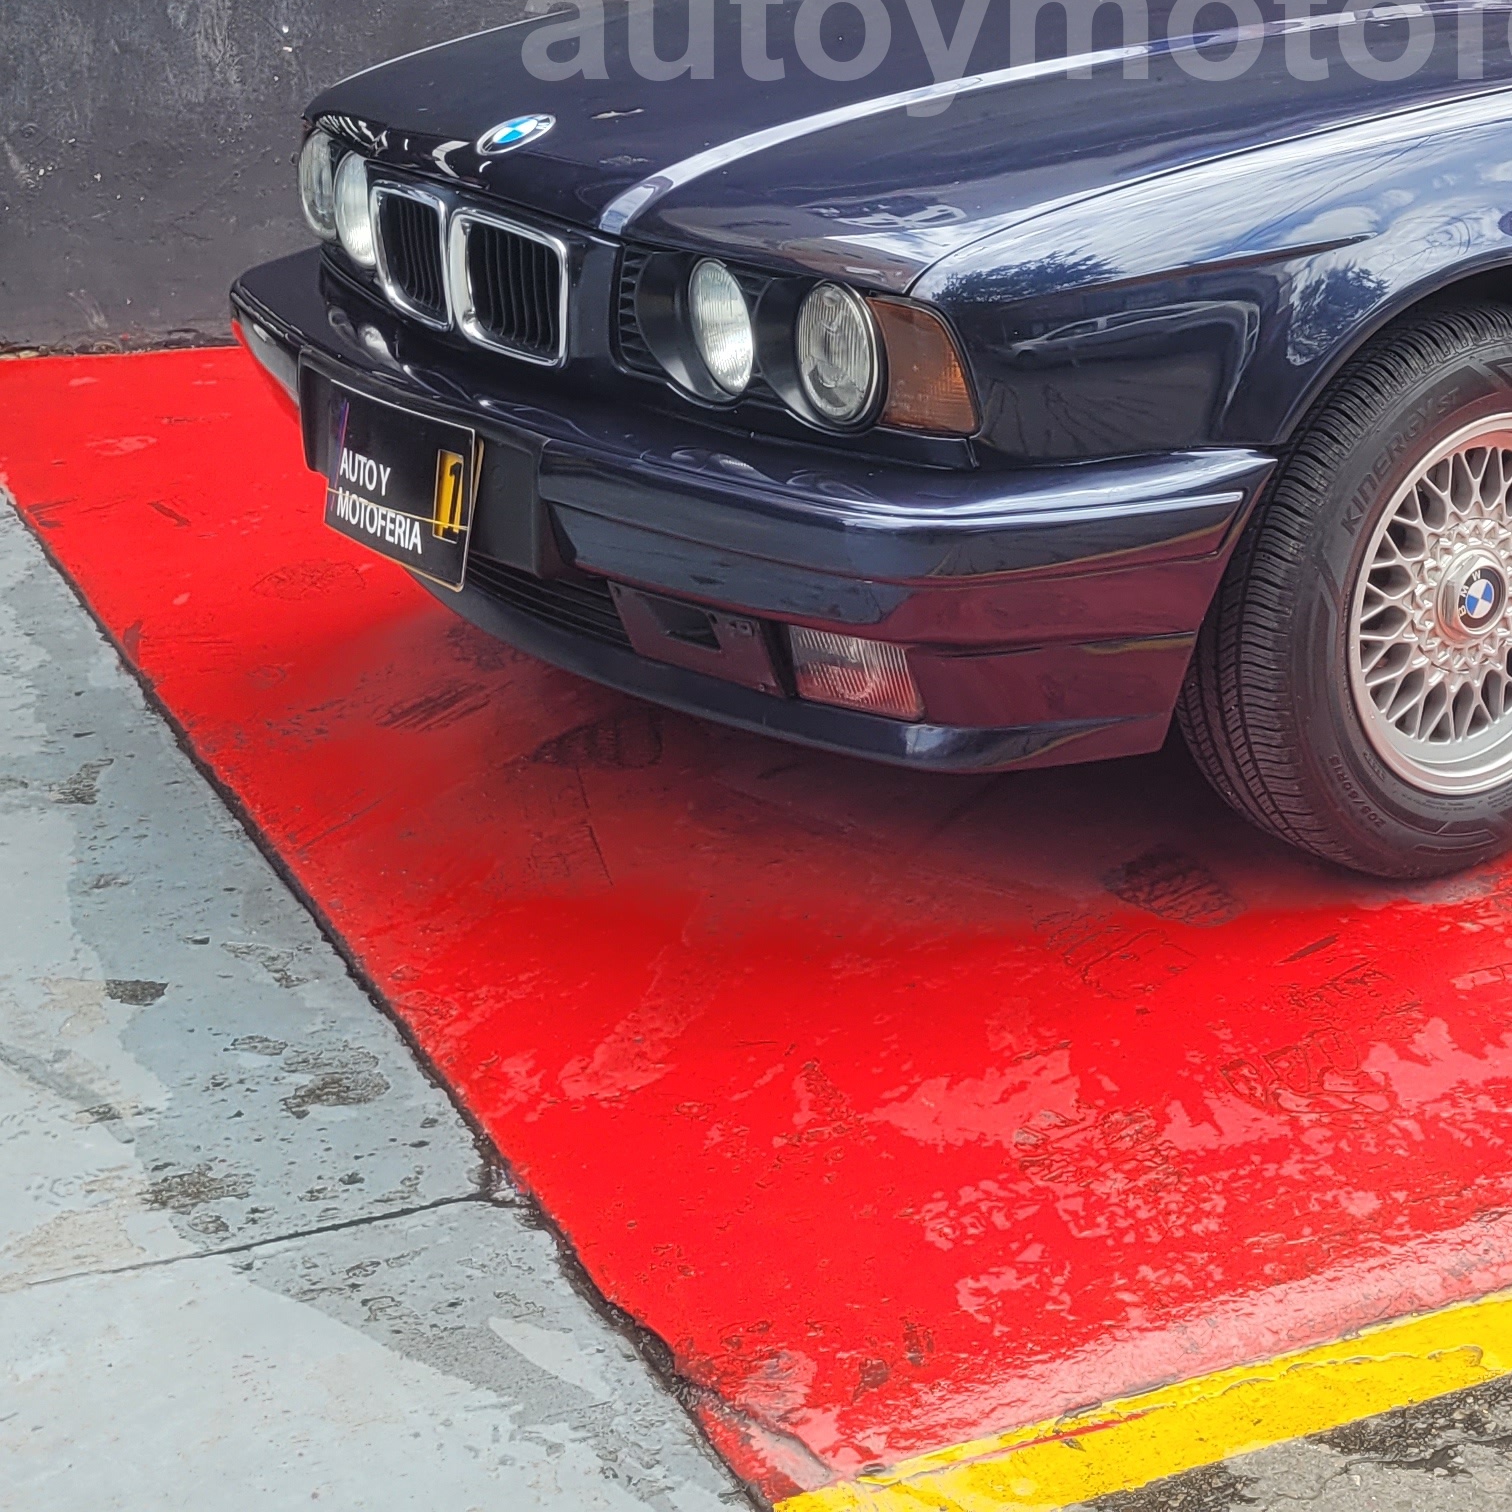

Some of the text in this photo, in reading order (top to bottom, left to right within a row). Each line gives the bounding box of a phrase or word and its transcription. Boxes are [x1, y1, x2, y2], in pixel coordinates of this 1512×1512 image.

[339, 447, 392, 497] AUTO Y
[336, 487, 423, 554] MOTOFERIA
